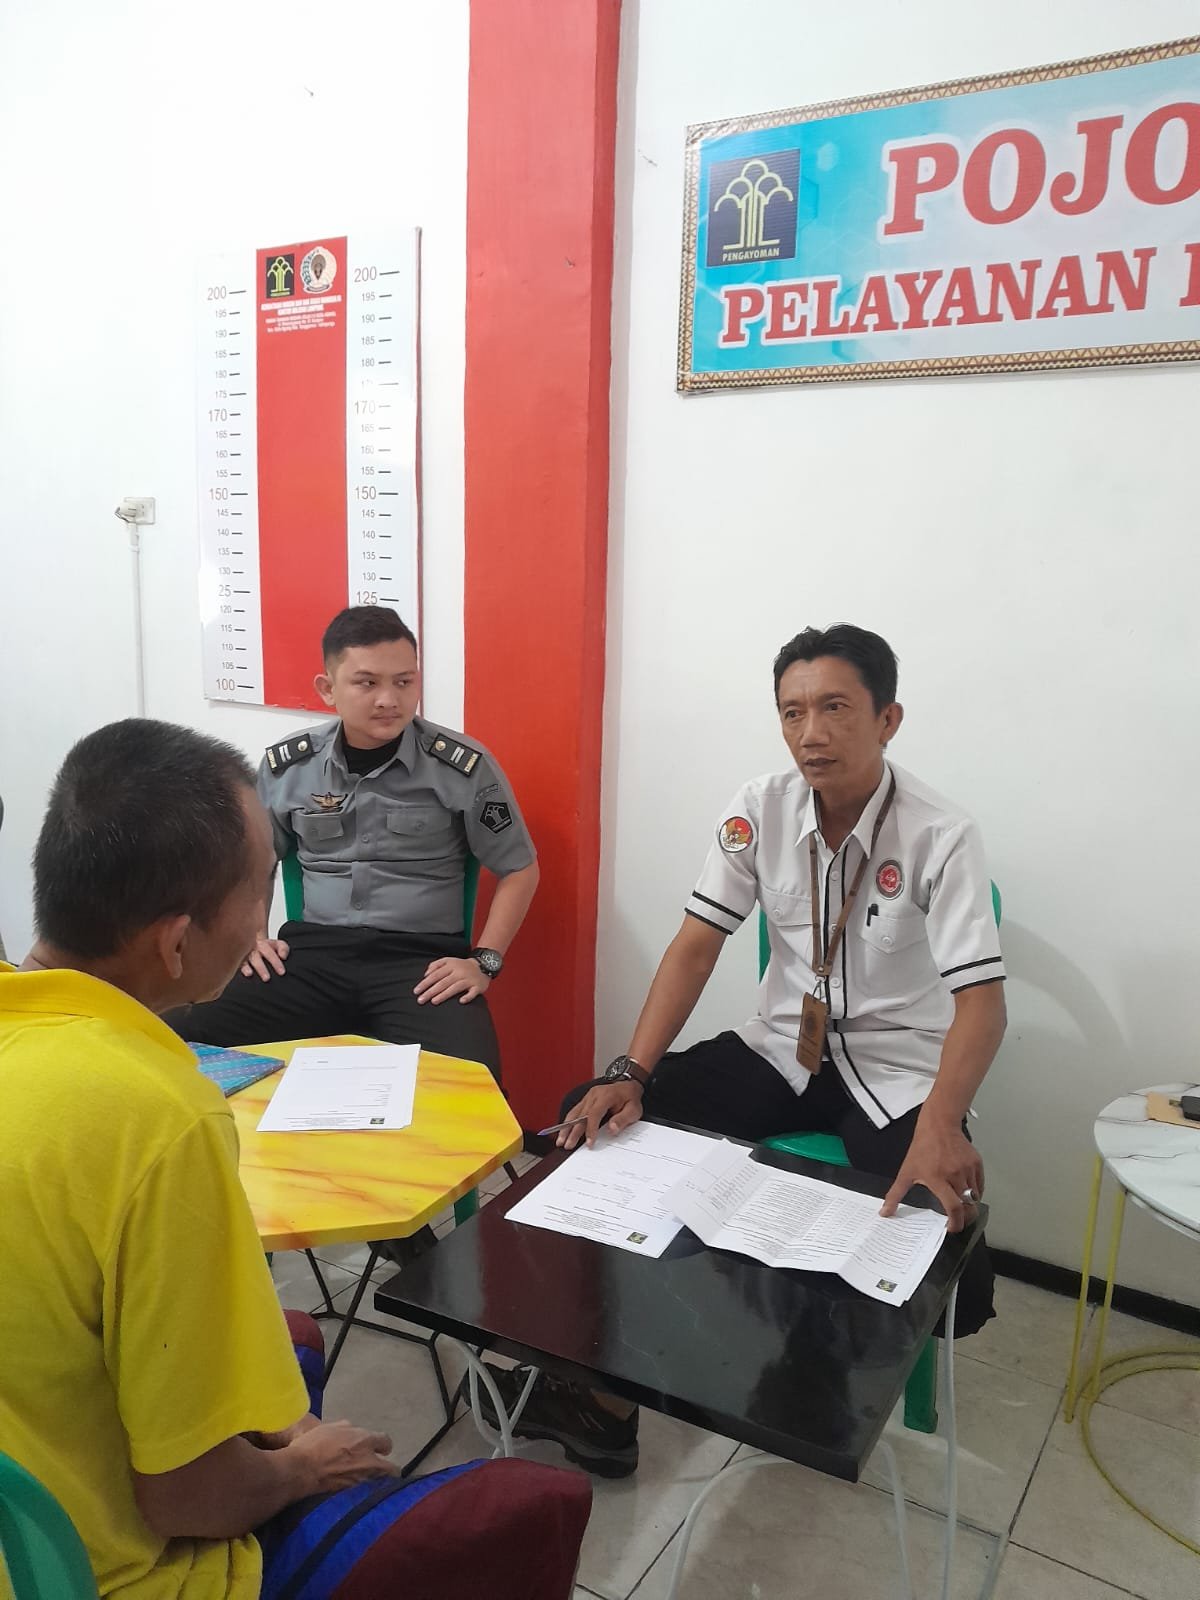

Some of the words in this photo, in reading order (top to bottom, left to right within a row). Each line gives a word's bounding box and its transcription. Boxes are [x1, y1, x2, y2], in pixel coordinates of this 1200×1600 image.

[883, 103, 1200, 235] POJO
[722, 248, 780, 262] PENGAYOMAN
[353, 266, 377, 282] 200
[206, 286, 226, 300] 200
[361, 292, 375, 301] 195
[722, 247, 1157, 343] PELAYANAN
[215, 309, 227, 318] 195
[361, 314, 375, 323] 190
[215, 329, 227, 338] 190
[360, 336, 375, 345] 185
[361, 358, 375, 367] 180
[215, 390, 227, 398] 175
[354, 400, 375, 415] 170
[208, 408, 227, 422] 170
[215, 469, 228, 477] 155
[360, 466, 374, 475] 155
[209, 488, 228, 500] 150
[354, 486, 376, 500] 150
[216, 509, 229, 517] 145
[361, 509, 375, 518] 145
[217, 528, 229, 536] 140
[362, 530, 375, 539] 140
[217, 547, 230, 555] 135
[362, 552, 375, 560] 135
[218, 567, 231, 575] 130
[362, 572, 376, 581] 130
[355, 591, 377, 606] 125
[220, 624, 232, 632] 115
[215, 678, 235, 691] 100
